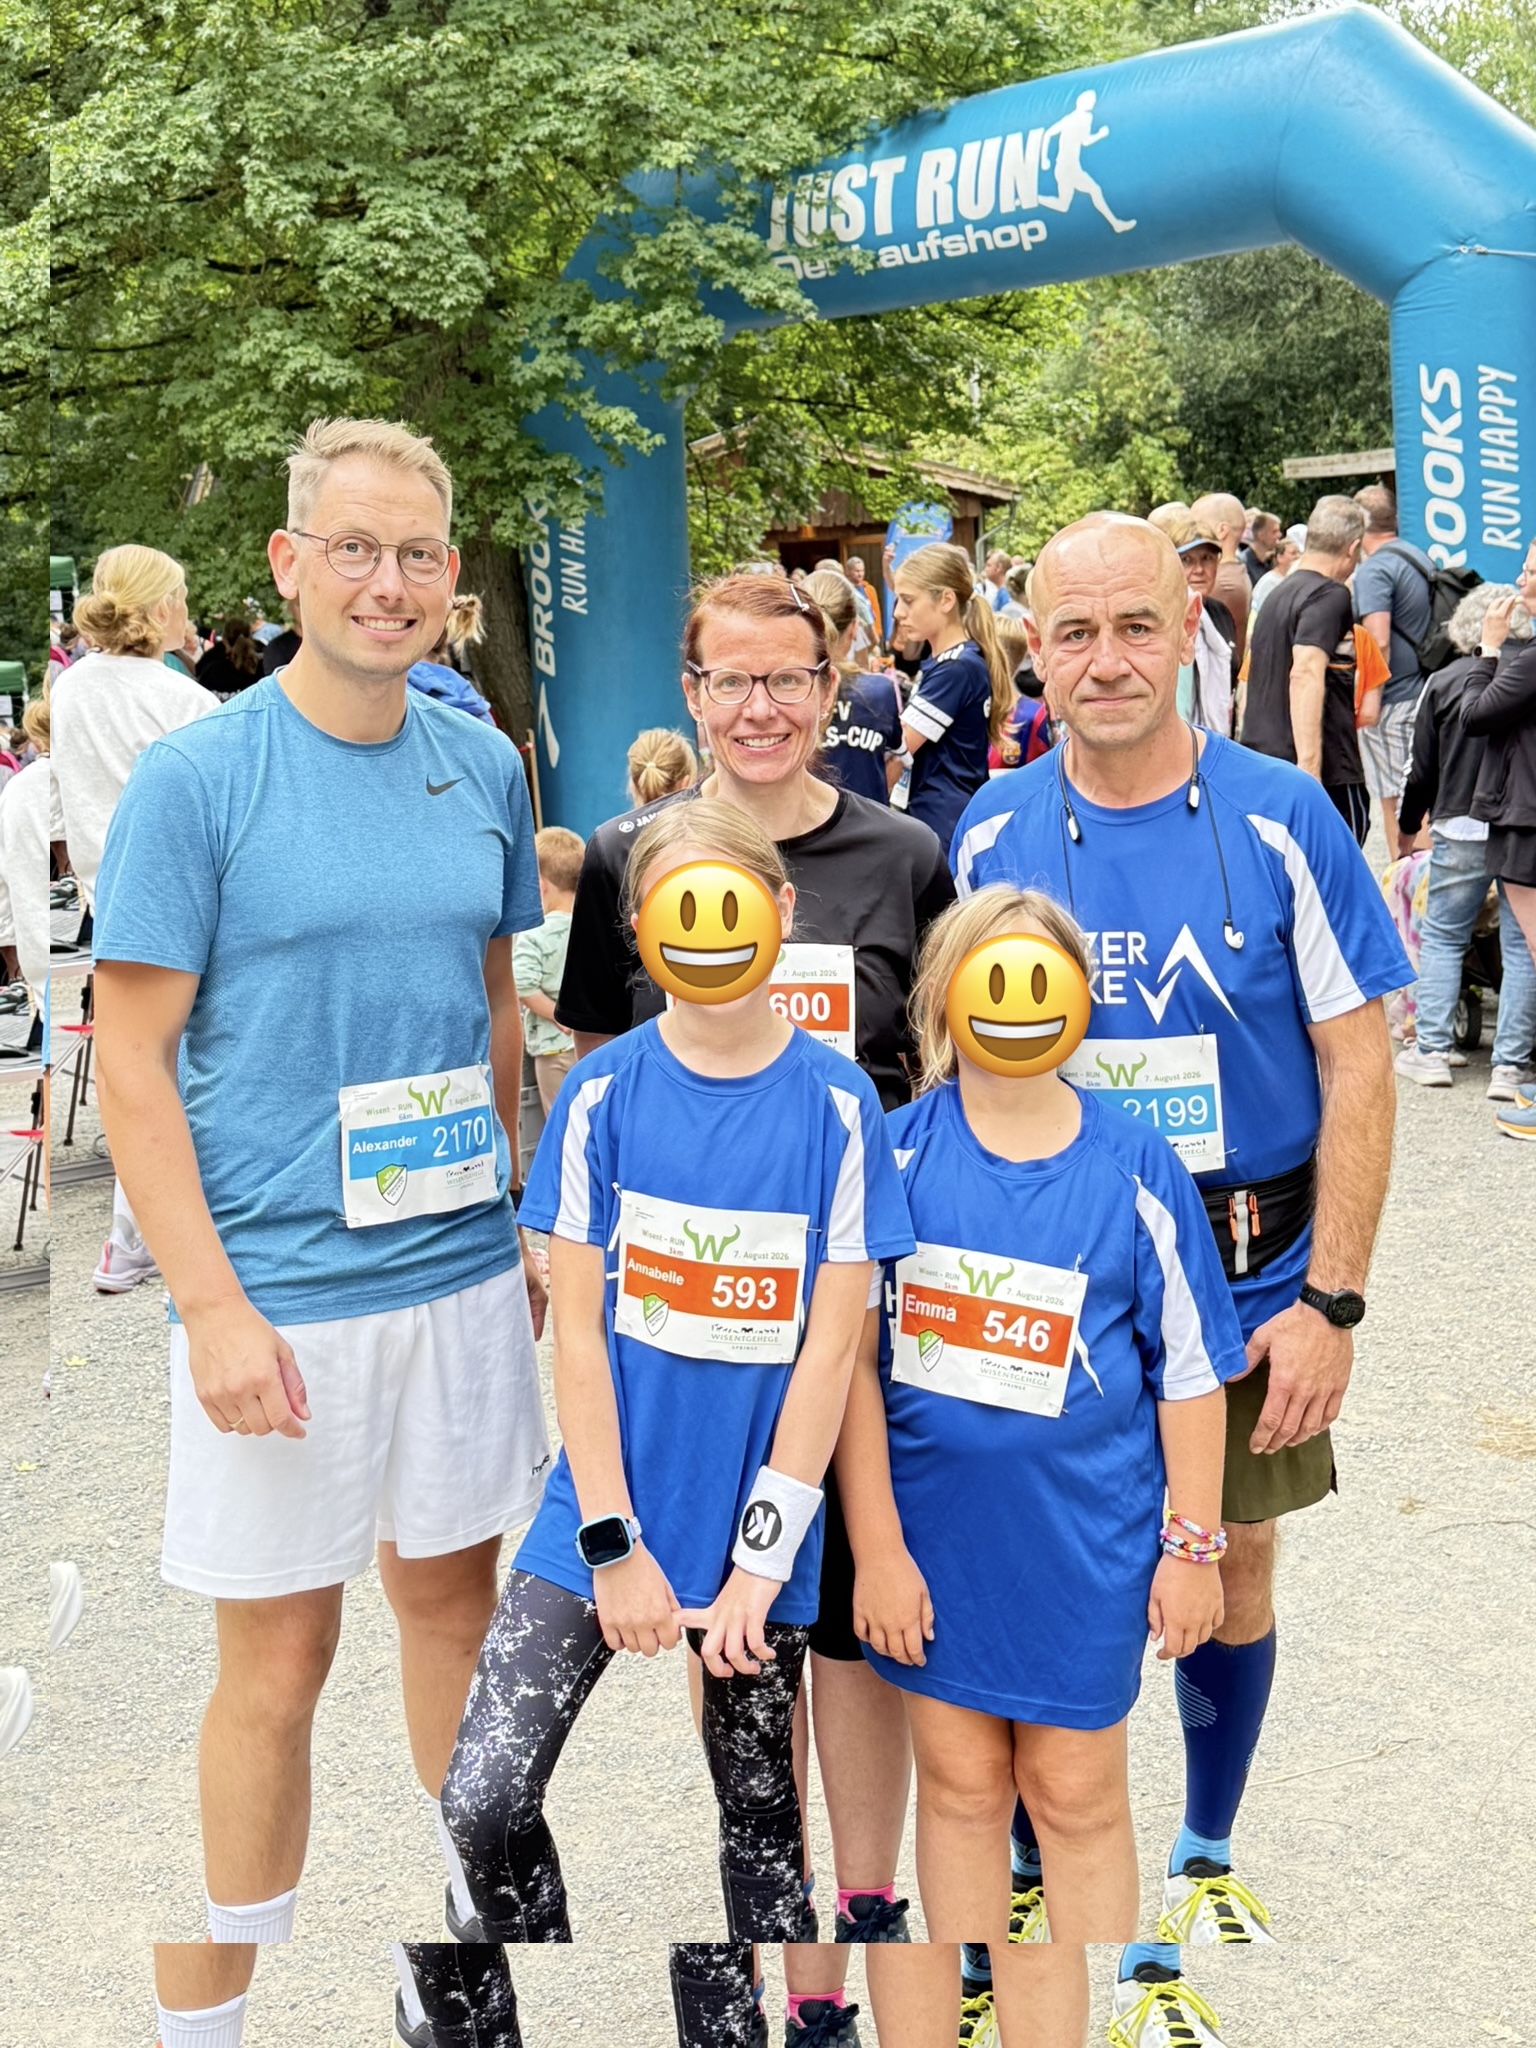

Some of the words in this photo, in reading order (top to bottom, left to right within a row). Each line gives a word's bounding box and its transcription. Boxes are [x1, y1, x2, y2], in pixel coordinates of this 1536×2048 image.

[916, 127, 1046, 229] RUN
[851, 219, 1048, 269] aufshop
[1477, 364, 1519, 473] HAPPY
[1418, 363, 1467, 570] ROOKS
[1481, 479, 1522, 550] RUN
[528, 498, 556, 678] BROOK
[560, 557, 588, 615] RUN
[822, 725, 883, 751] S-CUP
[1078, 931, 1149, 965] ZER
[792, 970, 817, 978] August
[819, 969, 838, 977] 2026
[1087, 970, 1128, 1004] KE
[768, 991, 831, 1021] 600
[1154, 1073, 1180, 1083] August
[1182, 1071, 1201, 1080] 2026
[365, 1106, 390, 1116] Wisent
[398, 1103, 413, 1112] RUN
[1123, 1095, 1208, 1128] 2199
[352, 1135, 418, 1155] Alexander
[432, 1116, 487, 1158] 2170
[669, 1236, 685, 1247] RUN
[743, 1251, 769, 1261] August
[770, 1252, 790, 1261] 2026
[626, 1257, 684, 1286] Annabelle
[711, 1274, 777, 1310] 593
[944, 1271, 960, 1281] RUN
[1006, 1287, 1014, 1296] 7.
[1016, 1289, 1043, 1303] August
[1045, 1295, 1065, 1306] 2026
[905, 1293, 957, 1322] Emma
[982, 1309, 1051, 1353] 546
